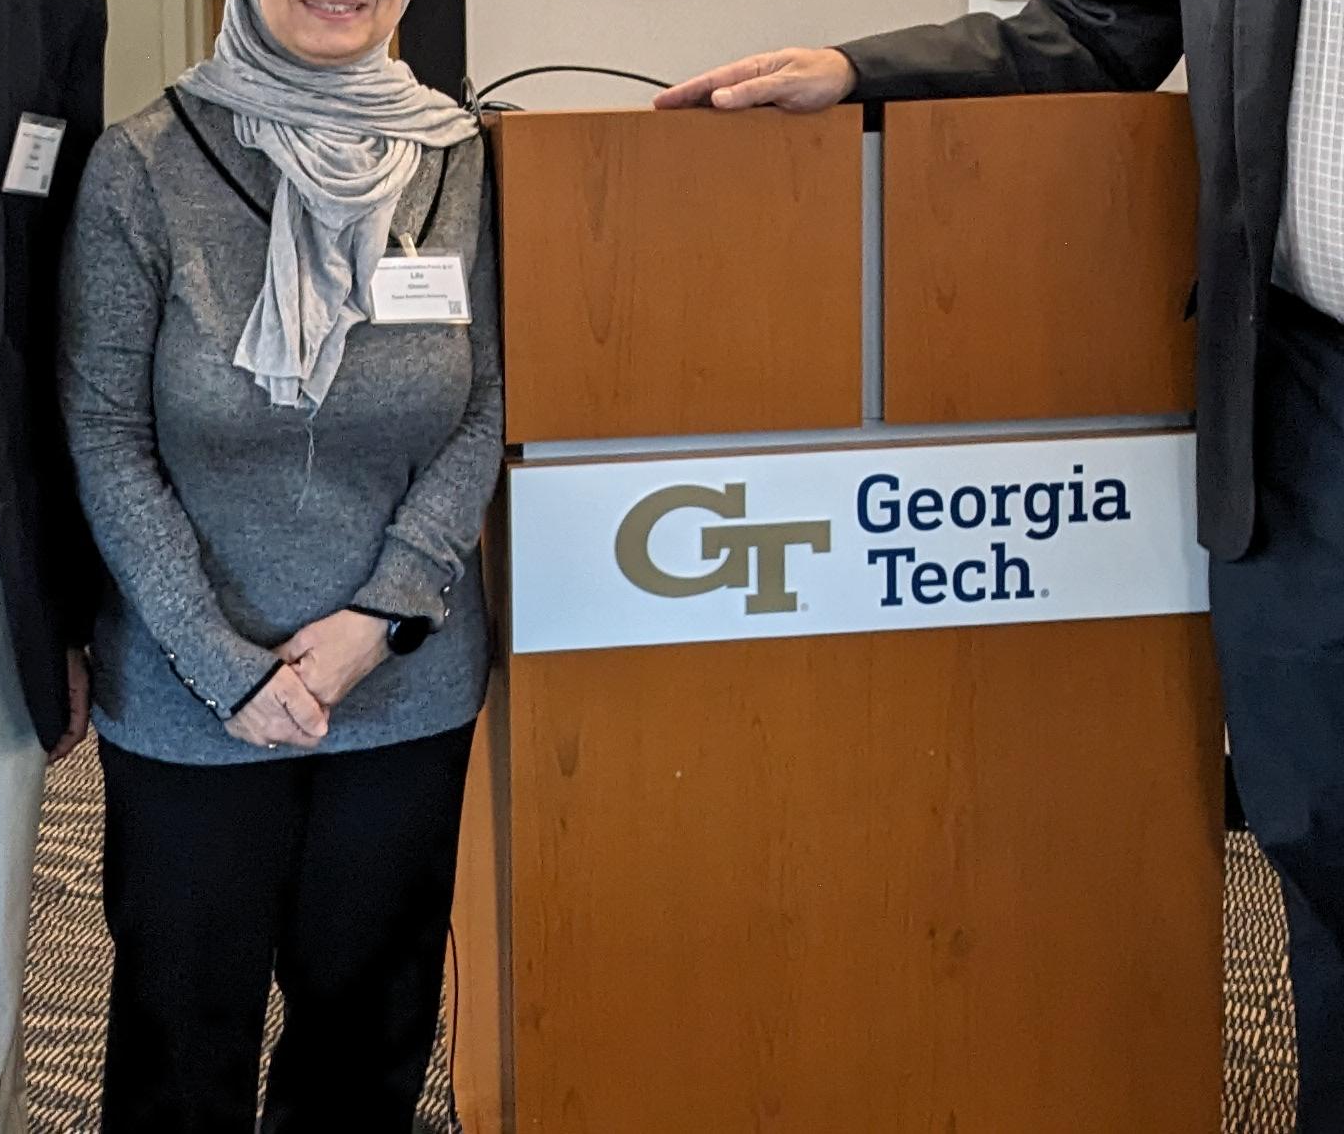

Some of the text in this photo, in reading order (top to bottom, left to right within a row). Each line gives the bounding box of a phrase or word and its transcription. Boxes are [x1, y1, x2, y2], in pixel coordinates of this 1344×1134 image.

[856, 464, 1131, 541] Georgia
[615, 482, 831, 616] GT
[867, 543, 1035, 607] Tech
